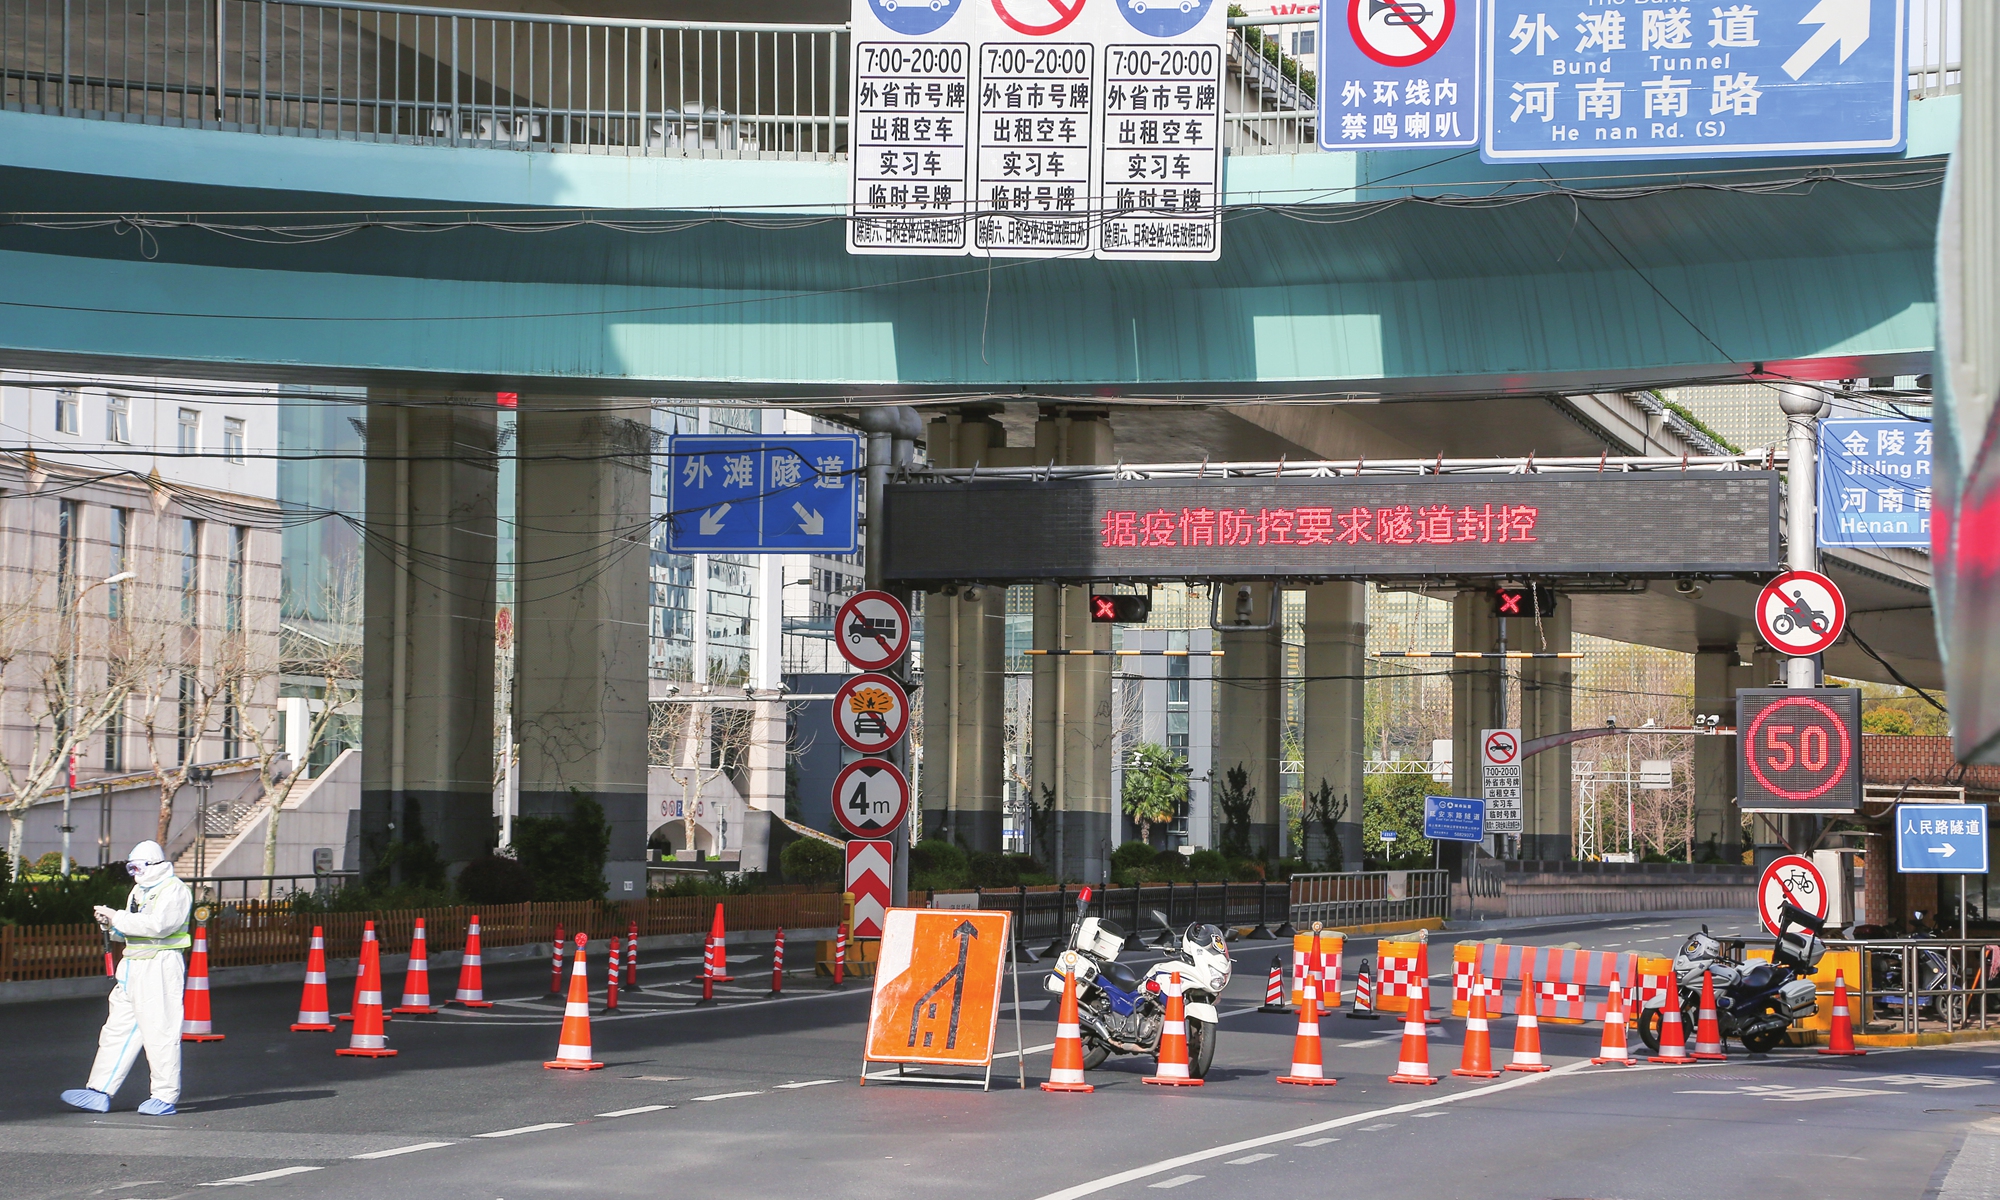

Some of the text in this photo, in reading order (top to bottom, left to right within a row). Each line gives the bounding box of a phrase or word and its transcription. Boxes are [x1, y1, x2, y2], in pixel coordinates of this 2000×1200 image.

[1509, 5, 1760, 56] 外滩隧道
[864, 48, 962, 73] 7:00-20:00
[988, 48, 1085, 74] 7:00-20:00
[1113, 50, 1212, 75] 7:00-20:00
[1553, 53, 1730, 75] Bund Tunnel
[860, 82, 965, 108] 外省市号牌
[983, 83, 1089, 109] 外省市号牌
[1108, 85, 1215, 110] 外省市号牌
[1341, 78, 1457, 107] 外环线内
[1509, 72, 1763, 123] 河南南路
[871, 116, 953, 142] 出租空车
[994, 117, 1076, 143] 出租空车
[1119, 119, 1203, 145] 出租空车
[1341, 111, 1461, 140] 禁鸣喇叭
[1651, 123, 1684, 138] Rd.
[1696, 121, 1725, 137] (S)
[880, 150, 941, 176] 实习车
[1003, 151, 1064, 177] 实习车
[1128, 153, 1190, 179] 实习车
[869, 184, 952, 210] 临时号牌
[991, 185, 1075, 211] 临时号牌
[1117, 188, 1201, 213] 临时号牌
[682, 455, 844, 489] 外滩隧道
[1845, 460, 1911, 478] Jinling
[1100, 504, 1538, 547] 据疫情防控要求隧道封控
[1841, 518, 1908, 533] Henan
[1767, 725, 1828, 772] 50
[1485, 767, 1518, 776] 7:00-20:00
[1485, 778, 1519, 787] 外省市号牌
[1489, 789, 1516, 797] 出租空车
[1493, 800, 1513, 808] 实习车
[1489, 810, 1517, 819] 临时号牌
[1904, 819, 1980, 836] 人民路隧道
